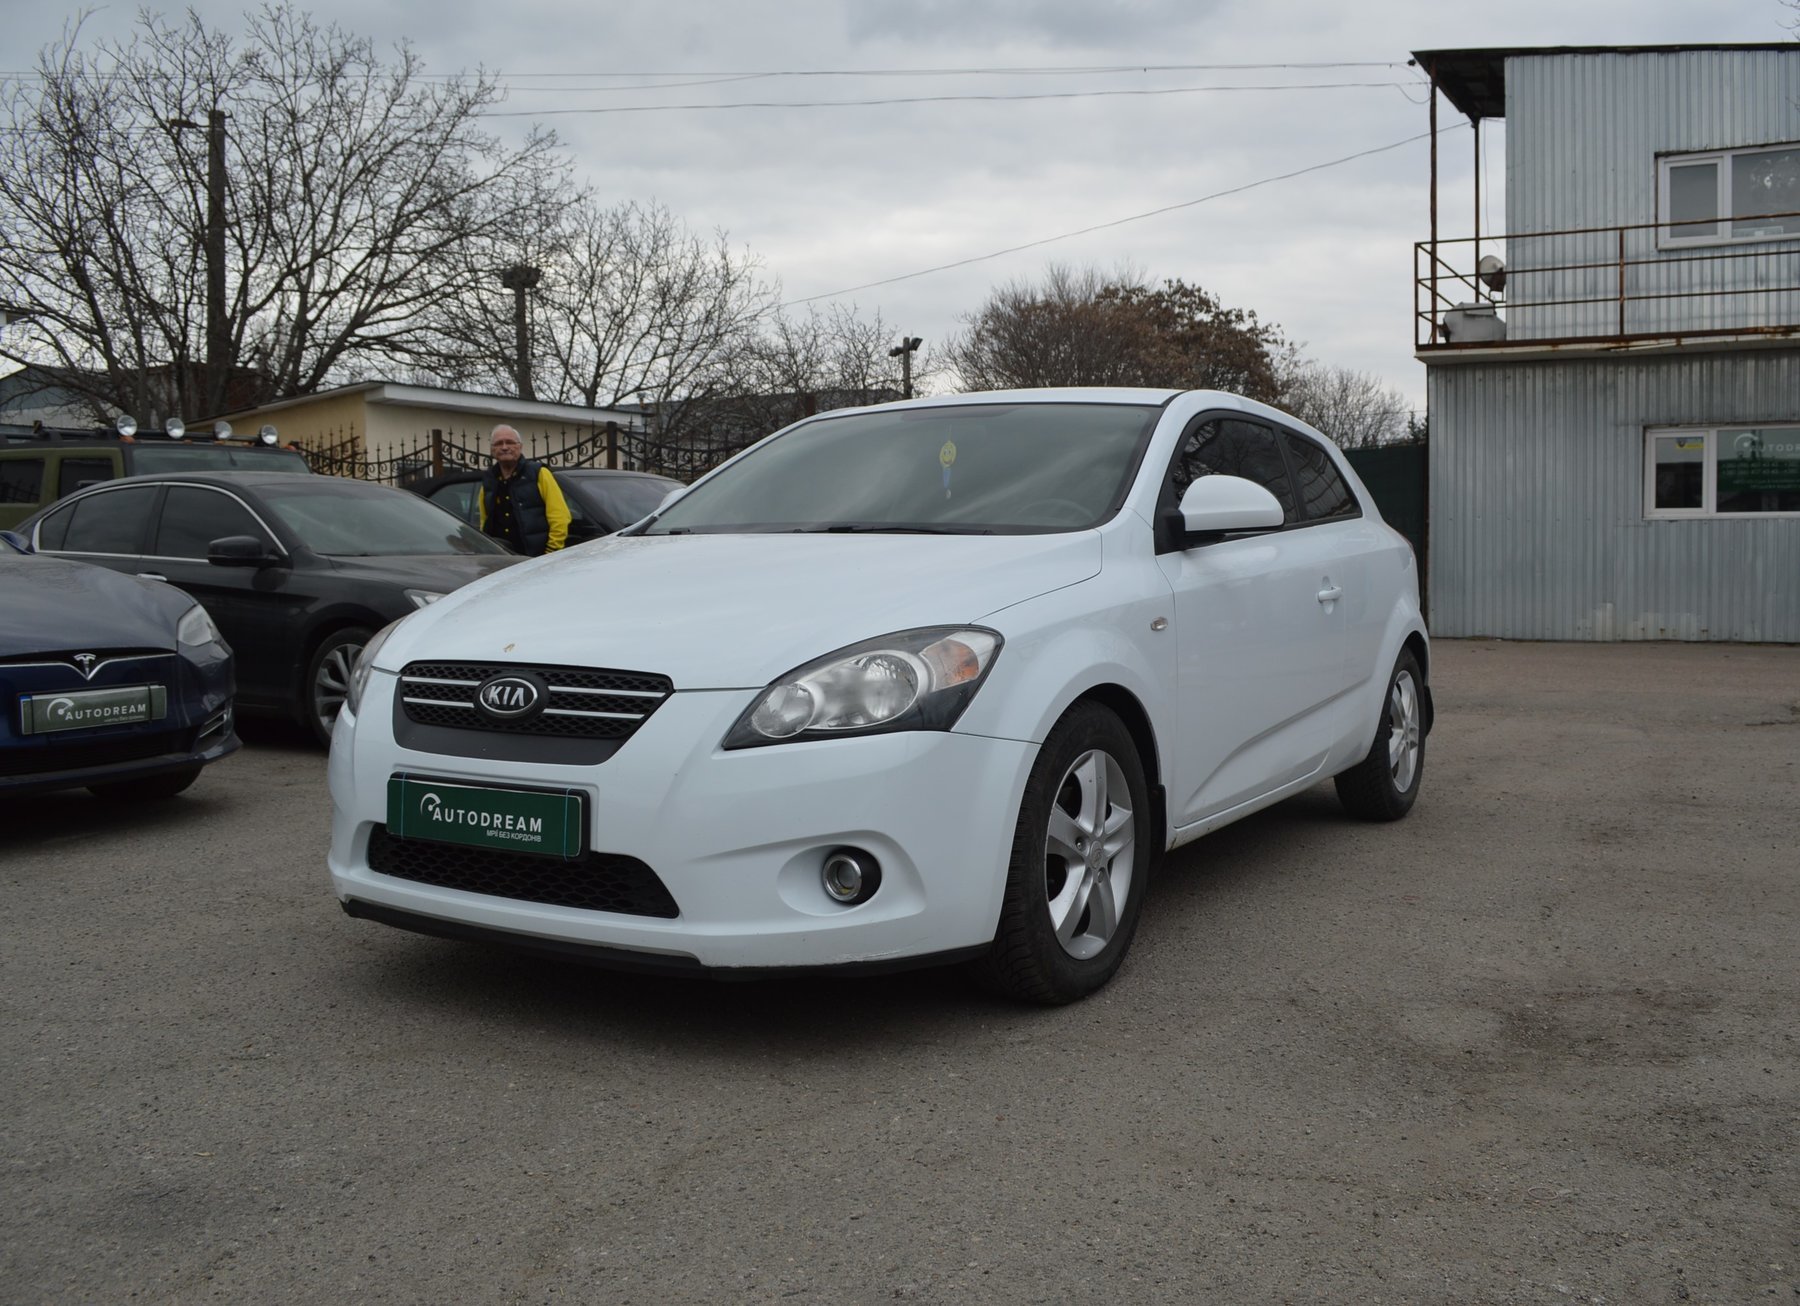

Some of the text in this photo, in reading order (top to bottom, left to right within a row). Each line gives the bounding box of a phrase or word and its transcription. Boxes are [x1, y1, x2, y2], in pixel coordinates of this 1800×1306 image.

[487, 685, 525, 707] KIA
[65, 703, 146, 721] AUTODREAM
[432, 807, 542, 833] AUTODREAM
